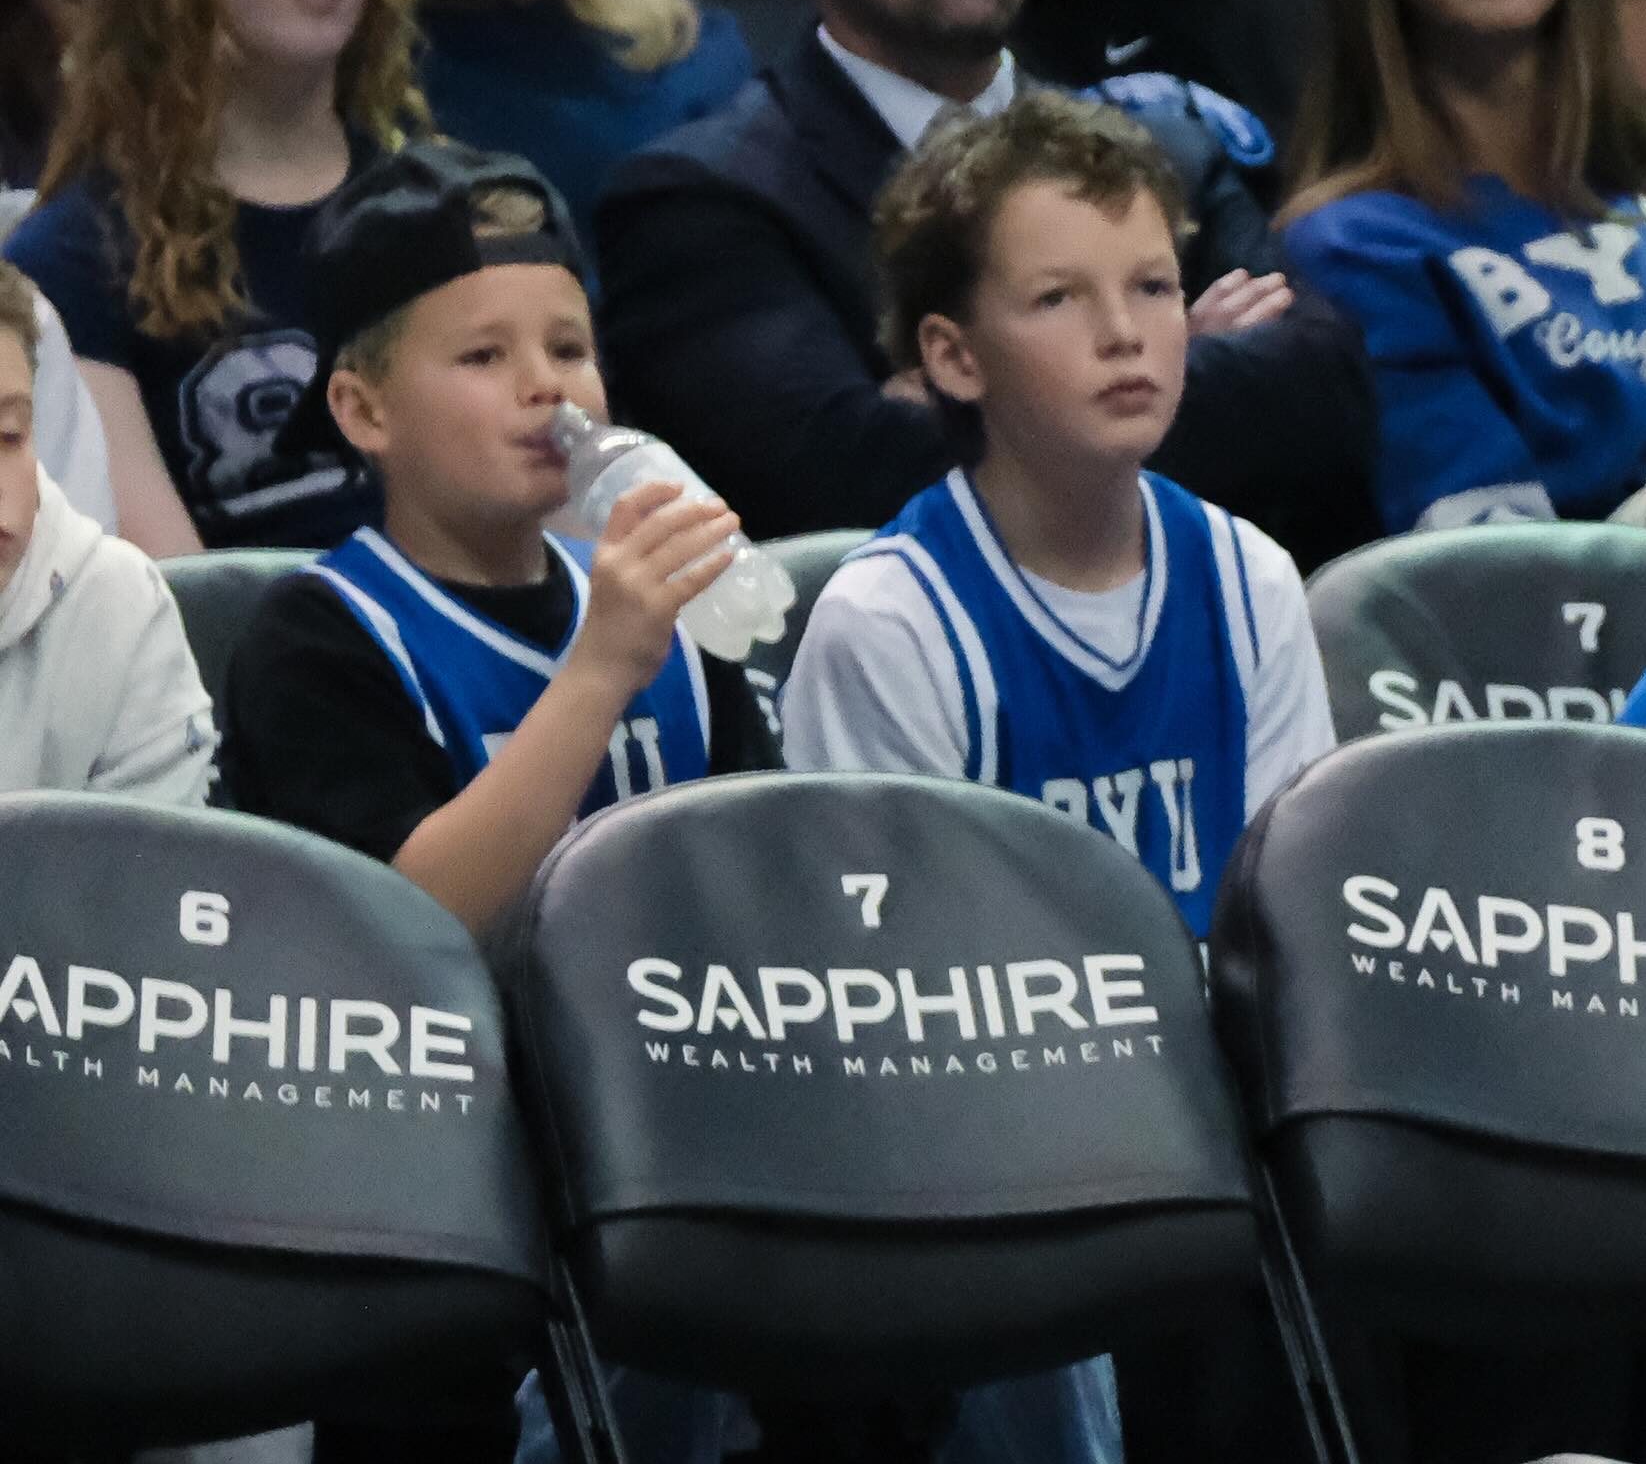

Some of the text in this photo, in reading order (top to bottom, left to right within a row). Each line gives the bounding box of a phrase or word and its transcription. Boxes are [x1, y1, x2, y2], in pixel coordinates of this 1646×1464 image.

[1561, 602, 1606, 652] 7
[1575, 816, 1626, 872] 8
[179, 889, 231, 946] 6
[840, 872, 889, 928] 7
[627, 954, 1159, 1043] SAPPHIRE
[1351, 953, 1520, 1003] WEALTH
[0, 954, 475, 1083] APPHIRE
[645, 1034, 1162, 1076] WEALTH MANAGEMENT
[137, 1065, 474, 1115] MANAGEMENT
